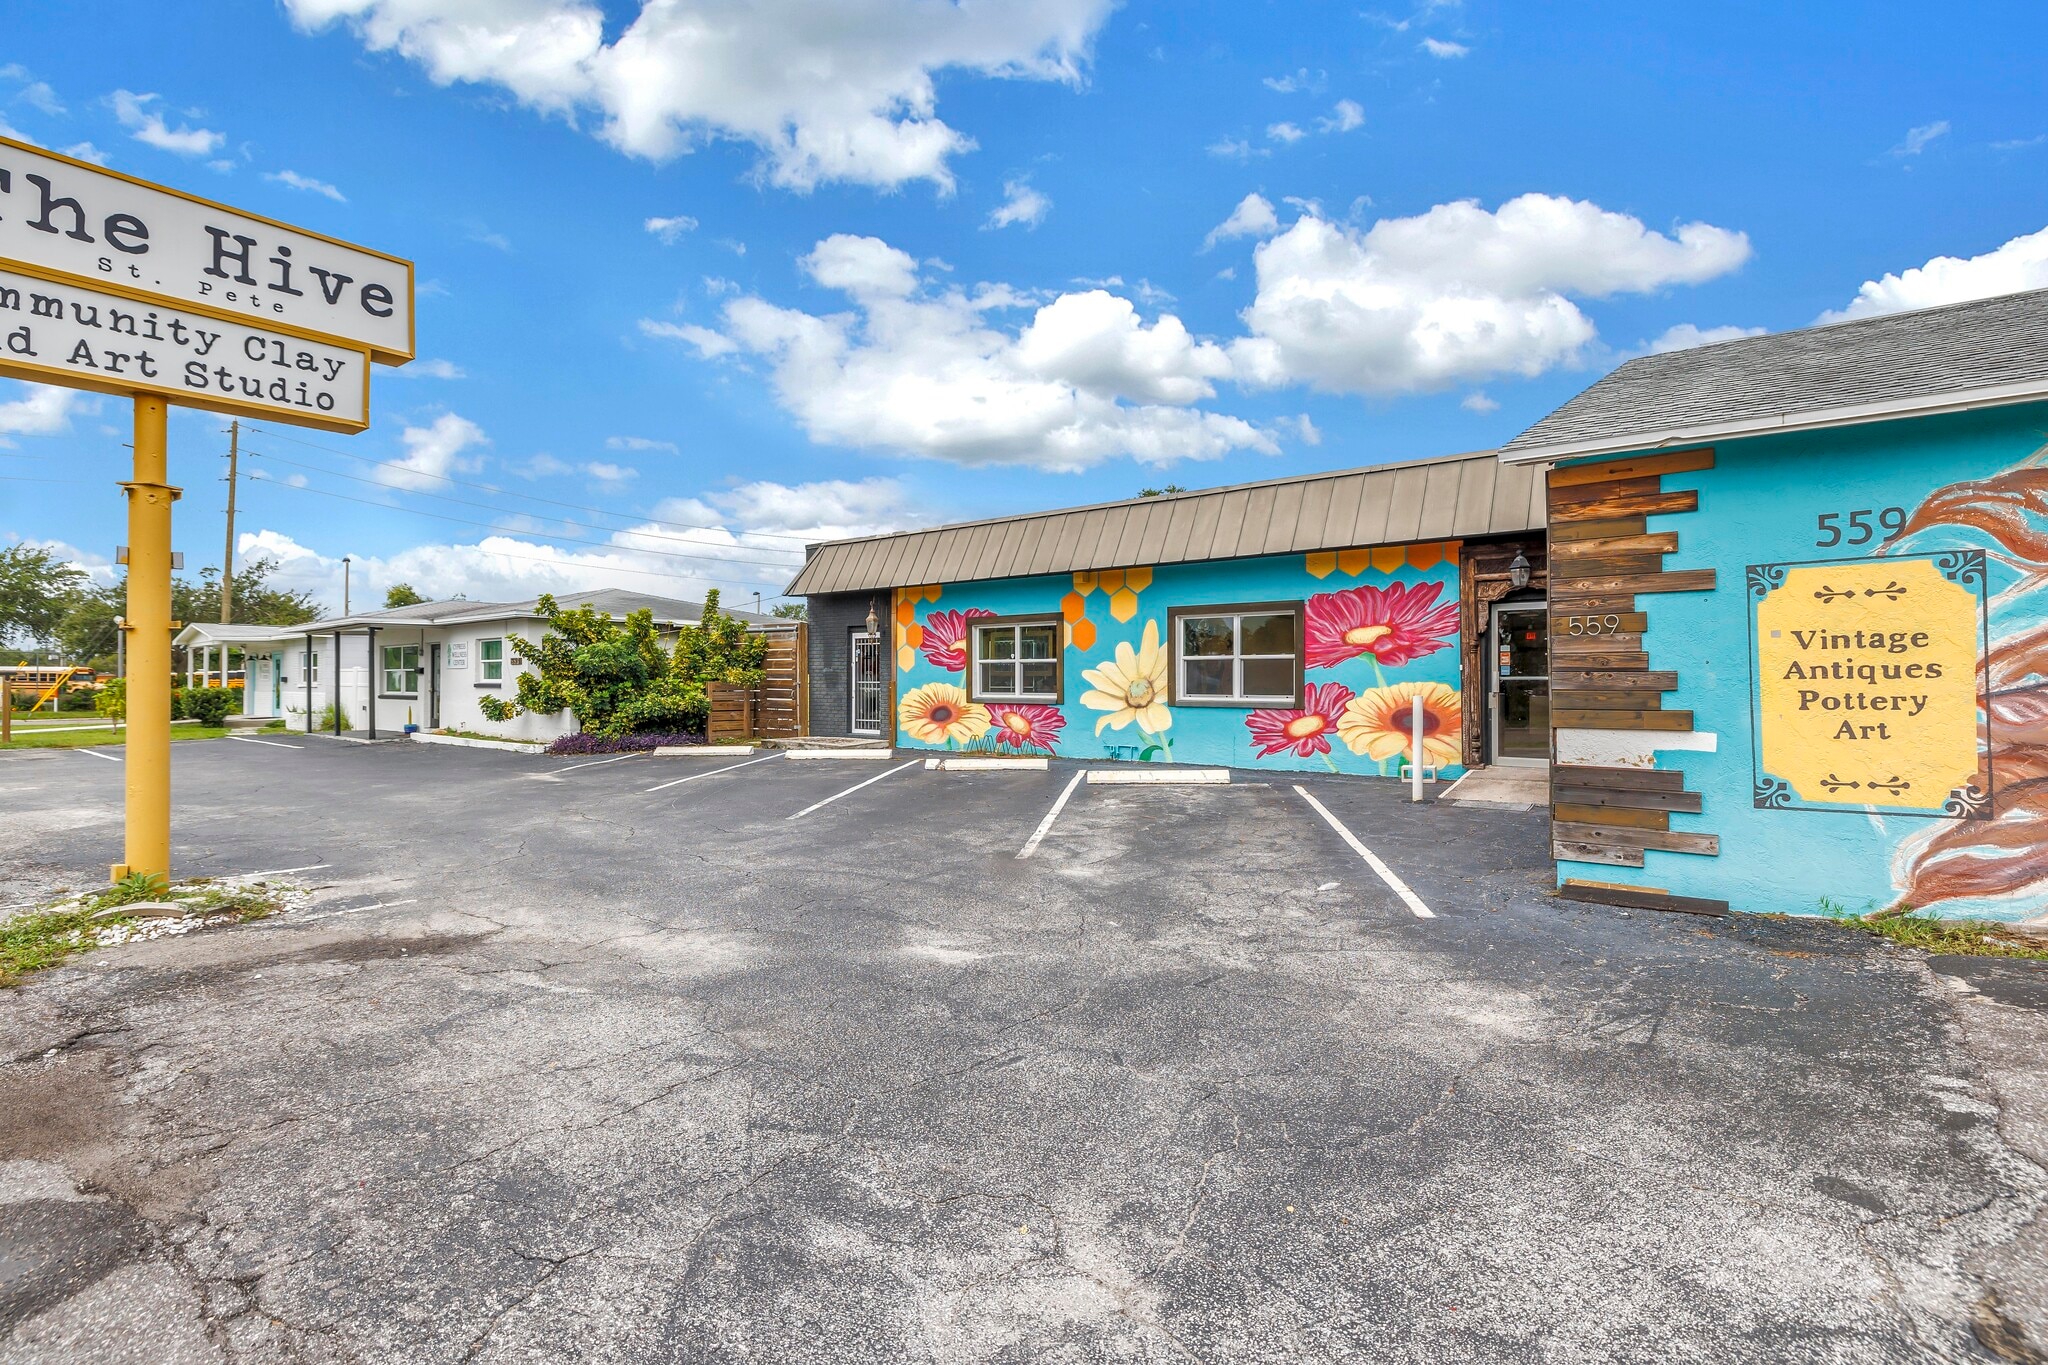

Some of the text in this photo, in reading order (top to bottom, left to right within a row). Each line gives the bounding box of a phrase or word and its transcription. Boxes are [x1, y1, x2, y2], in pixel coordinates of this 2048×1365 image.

[98, 257, 284, 313] St. Pete
[203, 225, 394, 318] Hive
[66, 339, 158, 378] Art
[184, 361, 335, 411] Studio
[244, 336, 346, 382] Clay
[1816, 507, 1907, 548] 559
[1568, 614, 1620, 637] 559
[1790, 629, 1929, 654] Vintage
[1783, 658, 1943, 685] Antiques
[1798, 690, 1929, 717] Pottery
[1833, 719, 1892, 740] Art
